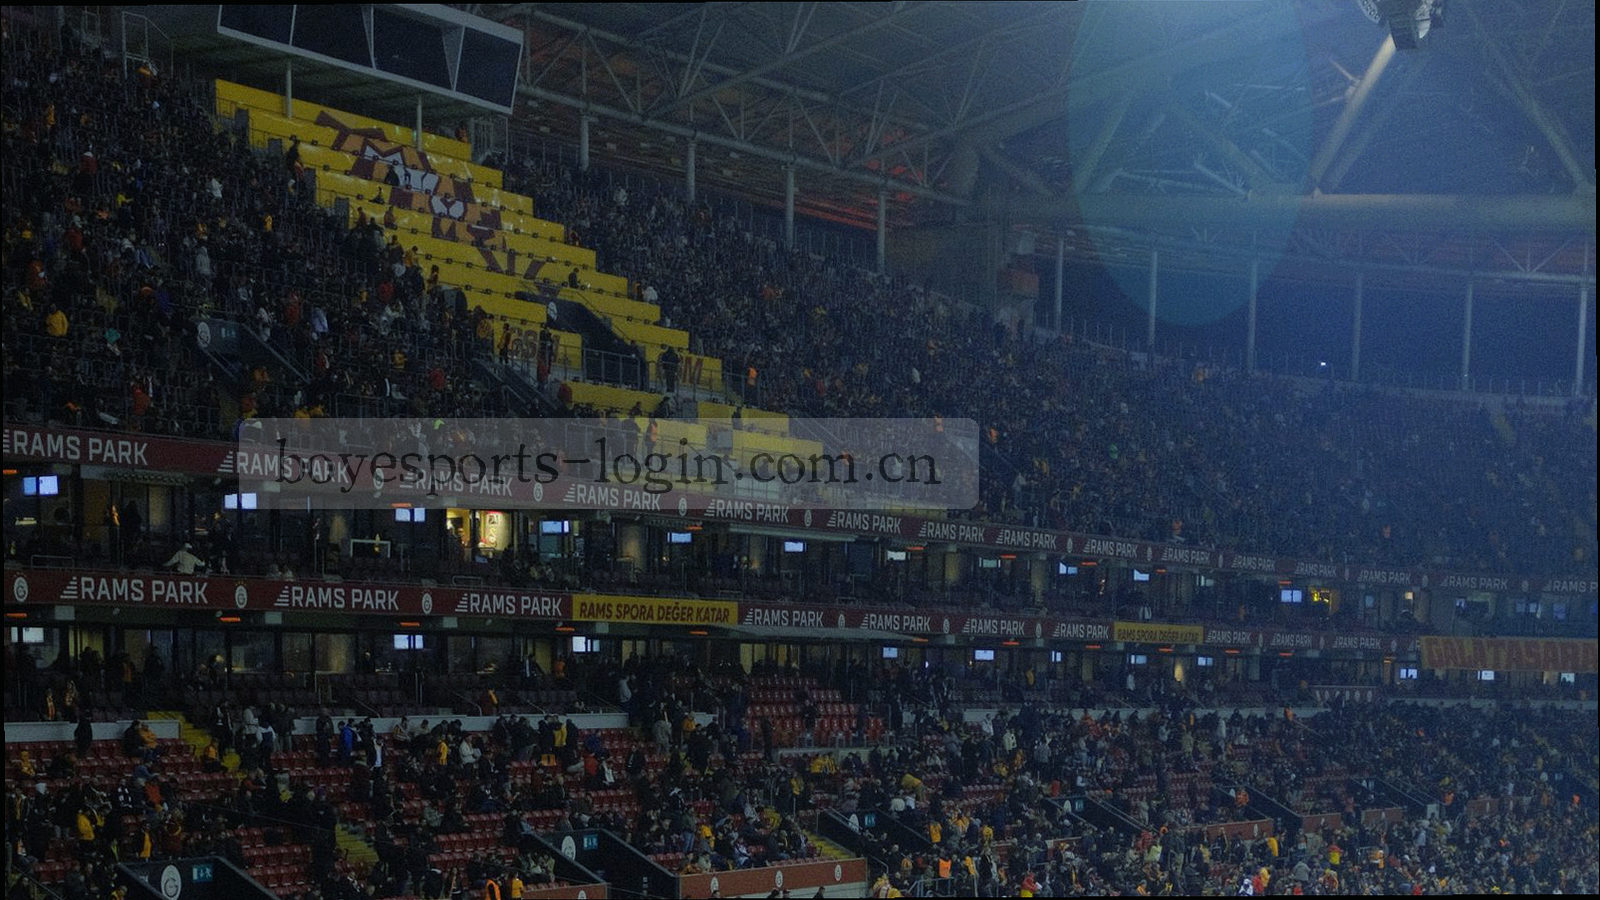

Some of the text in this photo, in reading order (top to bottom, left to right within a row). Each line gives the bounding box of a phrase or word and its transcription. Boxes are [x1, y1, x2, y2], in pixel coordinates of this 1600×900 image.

[13, 430, 148, 466] RAMS PARK
[236, 452, 349, 484] RAMS PARK
[415, 470, 512, 497] RAMS PARK
[577, 484, 661, 511] RAMS PARK
[714, 498, 790, 524] RAMS PARK
[836, 511, 901, 534] RAMS PARK
[927, 521, 985, 542] RAMS PARK
[1003, 530, 1057, 549] RAMS PARK
[1090, 539, 1138, 558] RAMS PARK
[1167, 547, 1210, 564] RAMS PARK
[1363, 569, 1412, 585] RAMS PARK
[1450, 575, 1508, 590] RAMS PARK
[1554, 580, 1586, 593] RAMS
[81, 576, 208, 604] RAMS PARK
[291, 586, 399, 611] RAMS PARK
[470, 593, 562, 617] RAMS PARK
[579, 602, 612, 619] RAMS
[615, 603, 654, 621] SPORA
[696, 606, 730, 623] KATAR
[753, 608, 824, 628] RAMS PARK
[868, 613, 931, 632] RAMS PARK
[971, 618, 1025, 636] RAMS PARK
[1060, 623, 1109, 639] RAMS PARK
[1211, 630, 1251, 644] RAMS PARK
[1338, 636, 1382, 649] RAMS PARK
